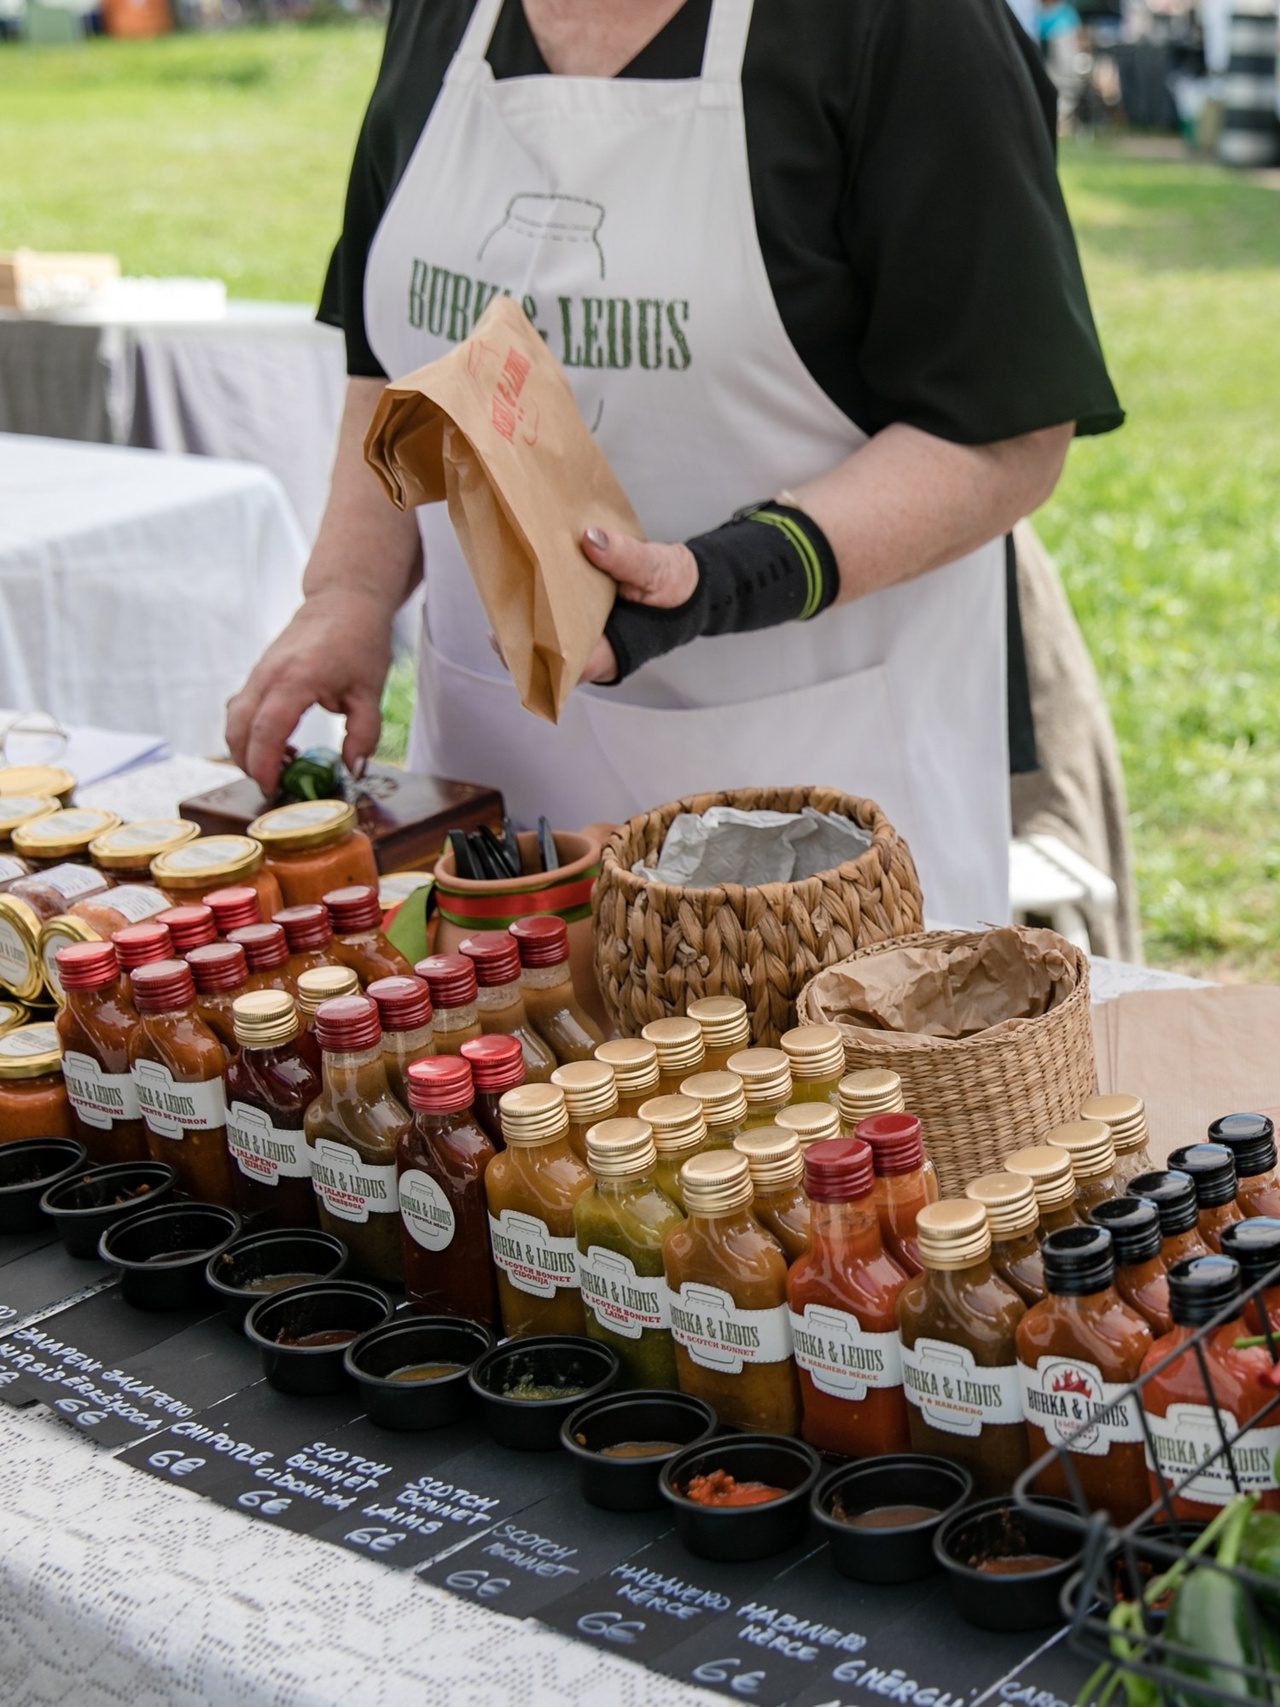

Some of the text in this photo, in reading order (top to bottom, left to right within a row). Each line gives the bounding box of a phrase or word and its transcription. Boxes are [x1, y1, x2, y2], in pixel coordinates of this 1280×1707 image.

[408, 258, 510, 342] BURK
[558, 297, 692, 371] LEDUS
[92, 1083, 124, 1107] LEDUS
[163, 1092, 196, 1116] LEDUS
[252, 1134, 261, 1155] &
[261, 1138, 297, 1165] LEDUS
[338, 1171, 348, 1192] &
[348, 1174, 388, 1200] LEDUS
[429, 1204, 452, 1226] LEDUS
[504, 1259, 572, 1283] SCOTCH BONNET
[524, 1242, 536, 1266] &
[536, 1245, 577, 1274] LEDUS
[591, 1297, 662, 1324] SCOTCH BONNET
[610, 1280, 621, 1304] &
[621, 1284, 661, 1314] LEDUS
[604, 1308, 630, 1323] LAIMS
[686, 1334, 756, 1357] SCOTCH BONNET
[706, 1316, 717, 1340] &
[718, 1319, 760, 1348] LEDUS
[808, 1359, 848, 1376] HABANERO
[827, 1340, 838, 1364] &
[840, 1343, 885, 1372] LEDUS
[101, 1368, 194, 1419] JALAPENO
[942, 1375, 954, 1400] &
[956, 1379, 1003, 1408] LEDUS
[1026, 1385, 1069, 1418] BURKA
[1071, 1396, 1083, 1420] &
[1085, 1401, 1129, 1427] LEDUS
[54, 1397, 108, 1425] 6€
[934, 1399, 984, 1417] HABANERO
[170, 1420, 274, 1467] CHIPOTLE
[148, 1450, 207, 1477] 6€
[285, 1452, 380, 1493] BONNET
[302, 1441, 393, 1480] SCOTCH
[404, 1475, 500, 1513] SCOTCH
[1225, 1473, 1272, 1484] RAPER
[237, 1490, 293, 1516] 6€
[361, 1502, 444, 1536] LAIMS
[395, 1489, 492, 1526] BONNET
[342, 1526, 407, 1552] 6€
[491, 1523, 579, 1562] SCOTCH
[481, 1541, 581, 1579] BONNET
[444, 1568, 512, 1598] 6€
[609, 1563, 730, 1613] HABANERO
[576, 1610, 647, 1645] 6€
[690, 1657, 767, 1694] 6€
